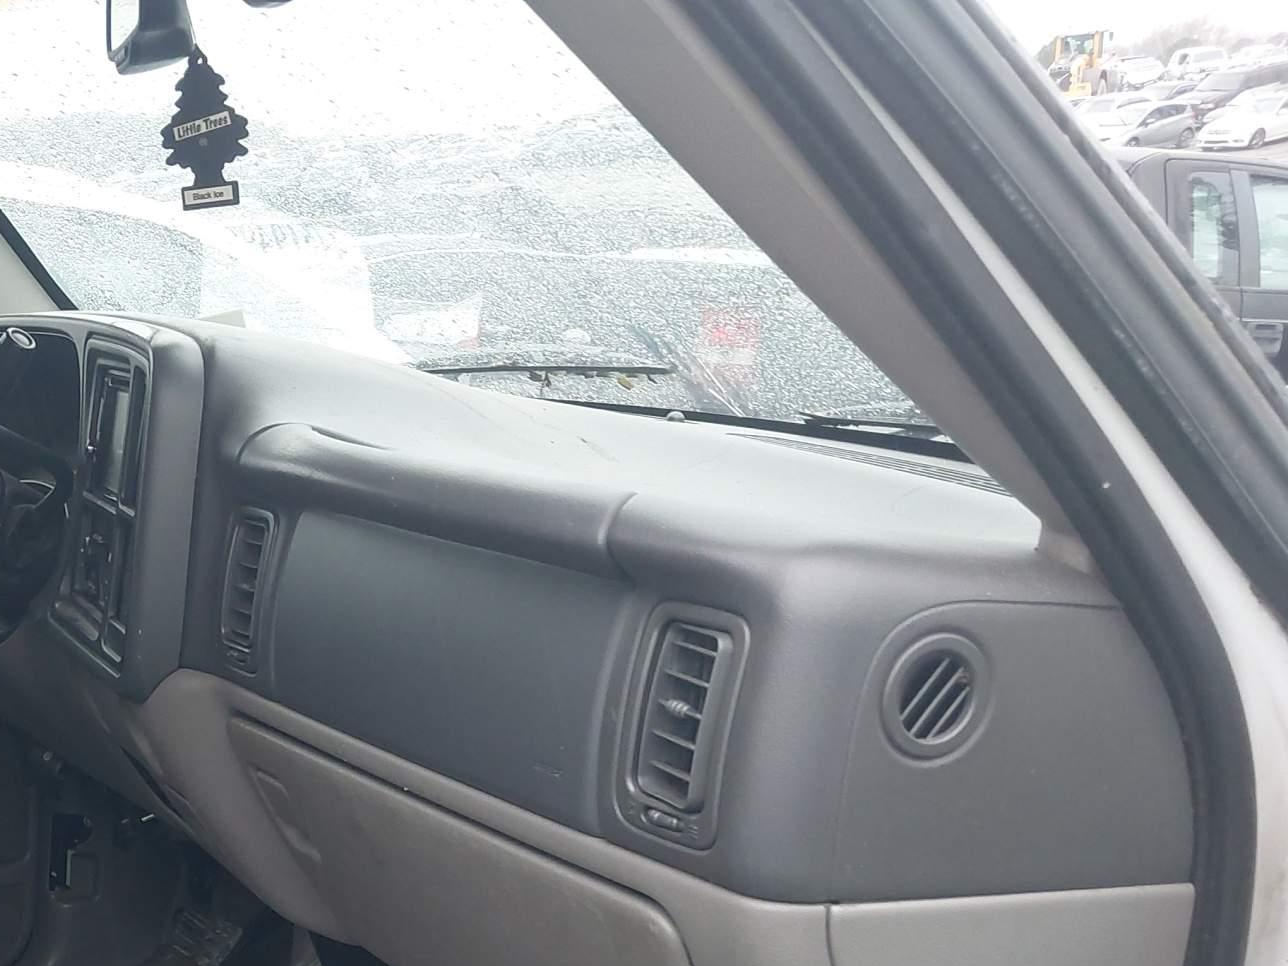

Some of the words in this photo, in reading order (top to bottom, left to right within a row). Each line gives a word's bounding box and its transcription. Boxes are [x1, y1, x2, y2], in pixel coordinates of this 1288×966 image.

[177, 122, 201, 138] Little
[202, 115, 228, 130] Trees
[192, 192, 212, 200] Black
[213, 191, 224, 199] Ice
